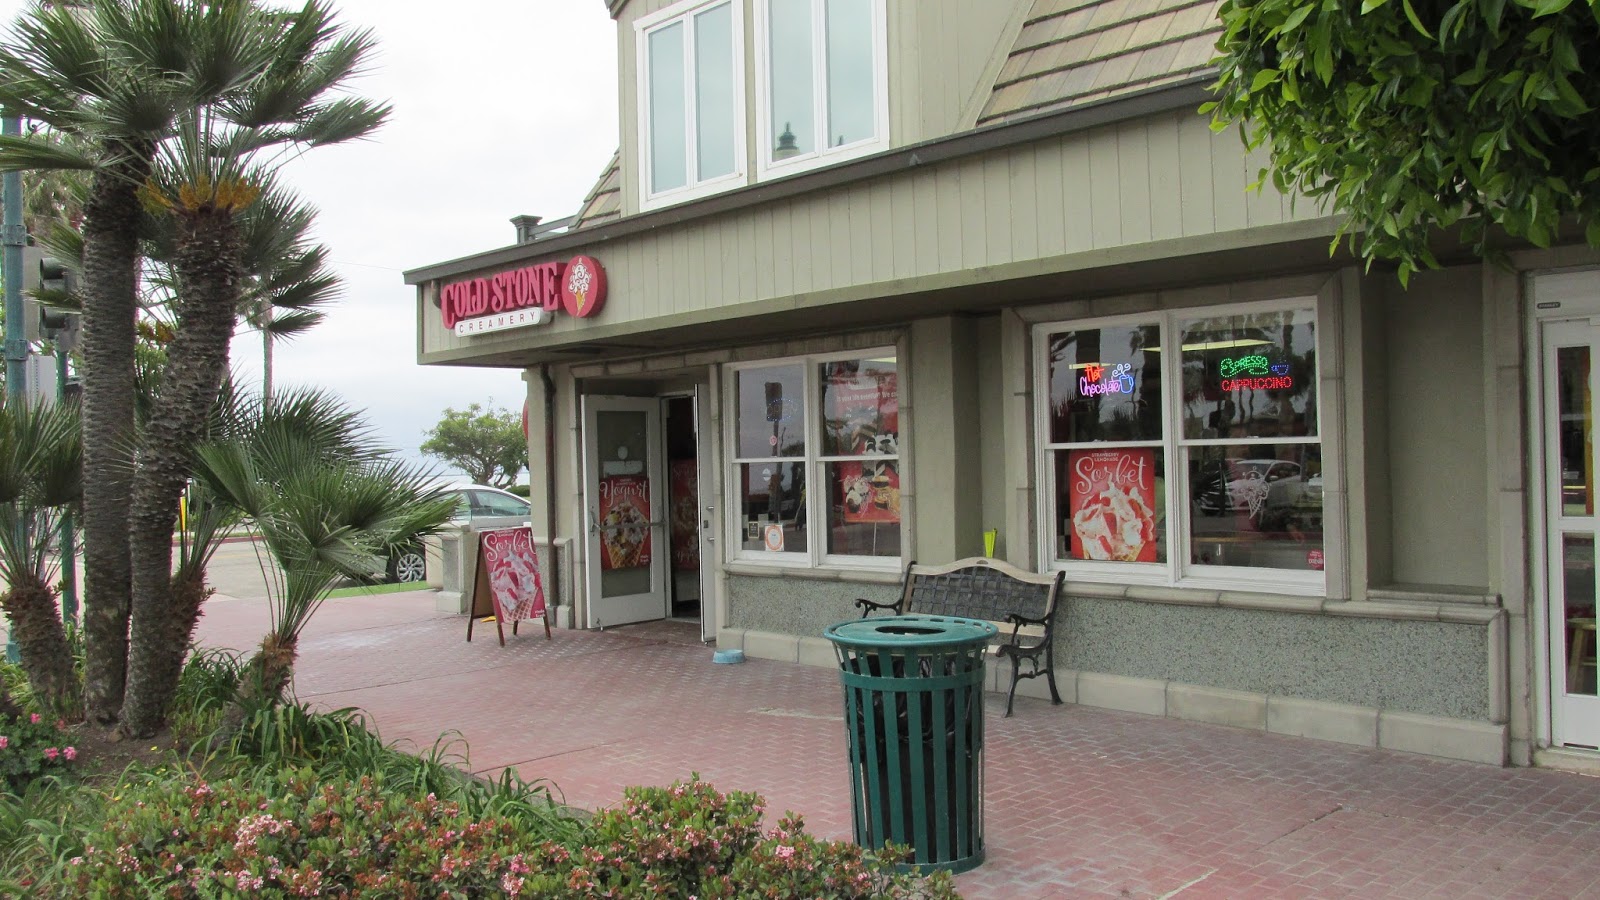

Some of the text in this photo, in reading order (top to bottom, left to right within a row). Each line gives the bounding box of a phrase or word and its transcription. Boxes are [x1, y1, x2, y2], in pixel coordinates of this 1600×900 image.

[441, 262, 559, 330] COLD STONE
[459, 311, 537, 333] CREAMERY
[1084, 362, 1105, 383] Hot
[1221, 376, 1292, 392] CAPPUCCINO
[1079, 375, 1121, 398] Chocolate
[1075, 454, 1148, 495] Sorbet
[600, 480, 649, 508] Yogurt
[484, 529, 537, 562] Sorbet
